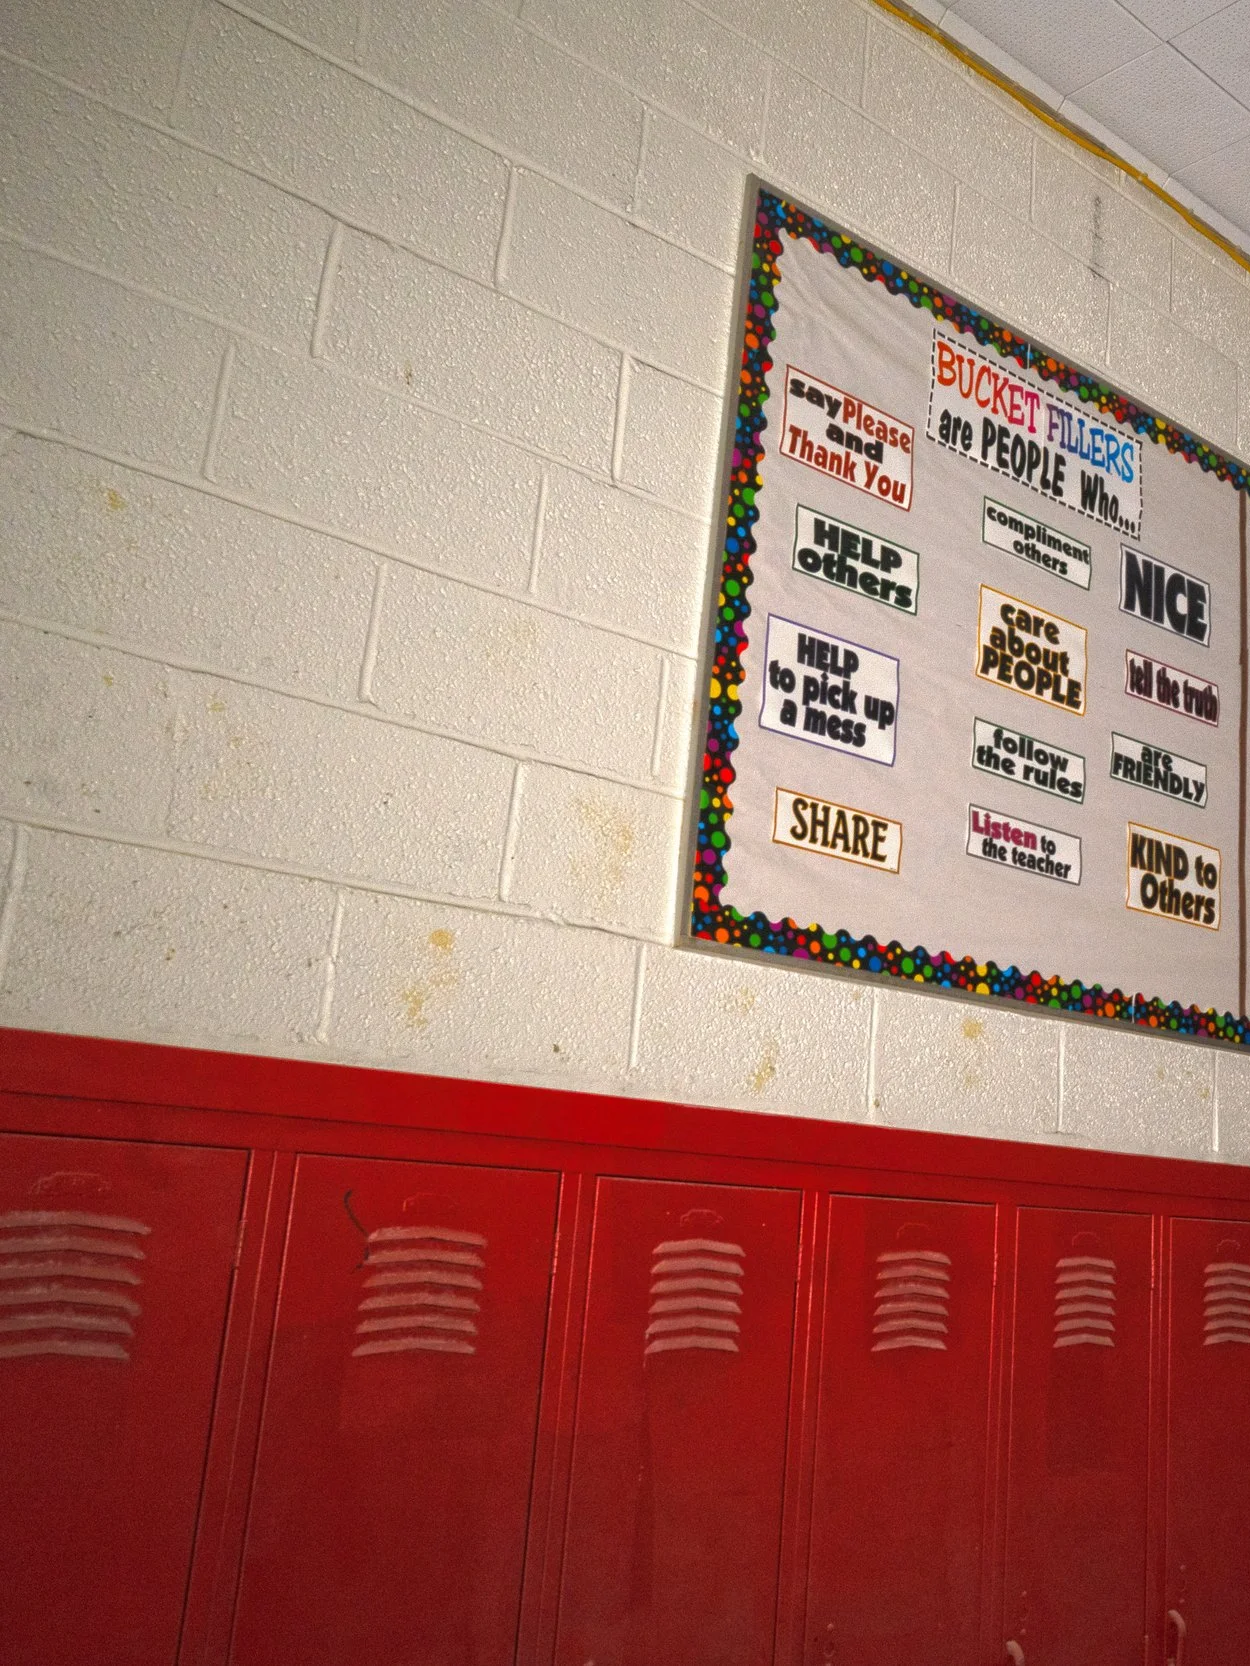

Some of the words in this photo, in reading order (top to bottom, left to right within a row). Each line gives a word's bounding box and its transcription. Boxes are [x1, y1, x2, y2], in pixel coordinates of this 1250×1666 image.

[788, 378, 842, 420] say
[842, 396, 912, 454] Please
[937, 340, 1041, 434] BUCKET
[1046, 402, 1134, 484] FILLERS
[788, 424, 857, 482] Thank
[863, 460, 906, 504] You
[825, 423, 884, 464] and
[938, 408, 973, 451] are
[981, 416, 1067, 497] PEOPLE
[1080, 470, 1136, 534] Who...
[813, 517, 903, 574] HELP
[986, 506, 1090, 565] compliment
[1012, 540, 1068, 576] others
[797, 547, 913, 609] others
[1124, 549, 1208, 642] NICE
[1000, 603, 1060, 645] care
[797, 632, 860, 680] HELP
[980, 644, 1083, 710] PEOPLE
[989, 626, 1070, 678] about
[768, 659, 796, 694] to
[802, 671, 858, 715] pick
[864, 694, 895, 731] up
[1129, 658, 1154, 699] tell
[1156, 667, 1180, 709] the
[1183, 678, 1218, 722] truth
[779, 698, 798, 728] a
[803, 706, 867, 748] mess
[993, 728, 1069, 772] follow
[976, 745, 1016, 776] the
[1023, 765, 1083, 799] rules
[1112, 752, 1205, 802] FRIENDLY
[1141, 746, 1173, 772] are
[789, 797, 888, 862] SHARE
[971, 811, 1037, 850] Listen
[1040, 836, 1057, 856] to
[982, 837, 1007, 861] the
[1011, 847, 1071, 879] teacher
[1130, 832, 1189, 881] KIND
[1195, 855, 1218, 890] to
[1140, 873, 1216, 925] Others
